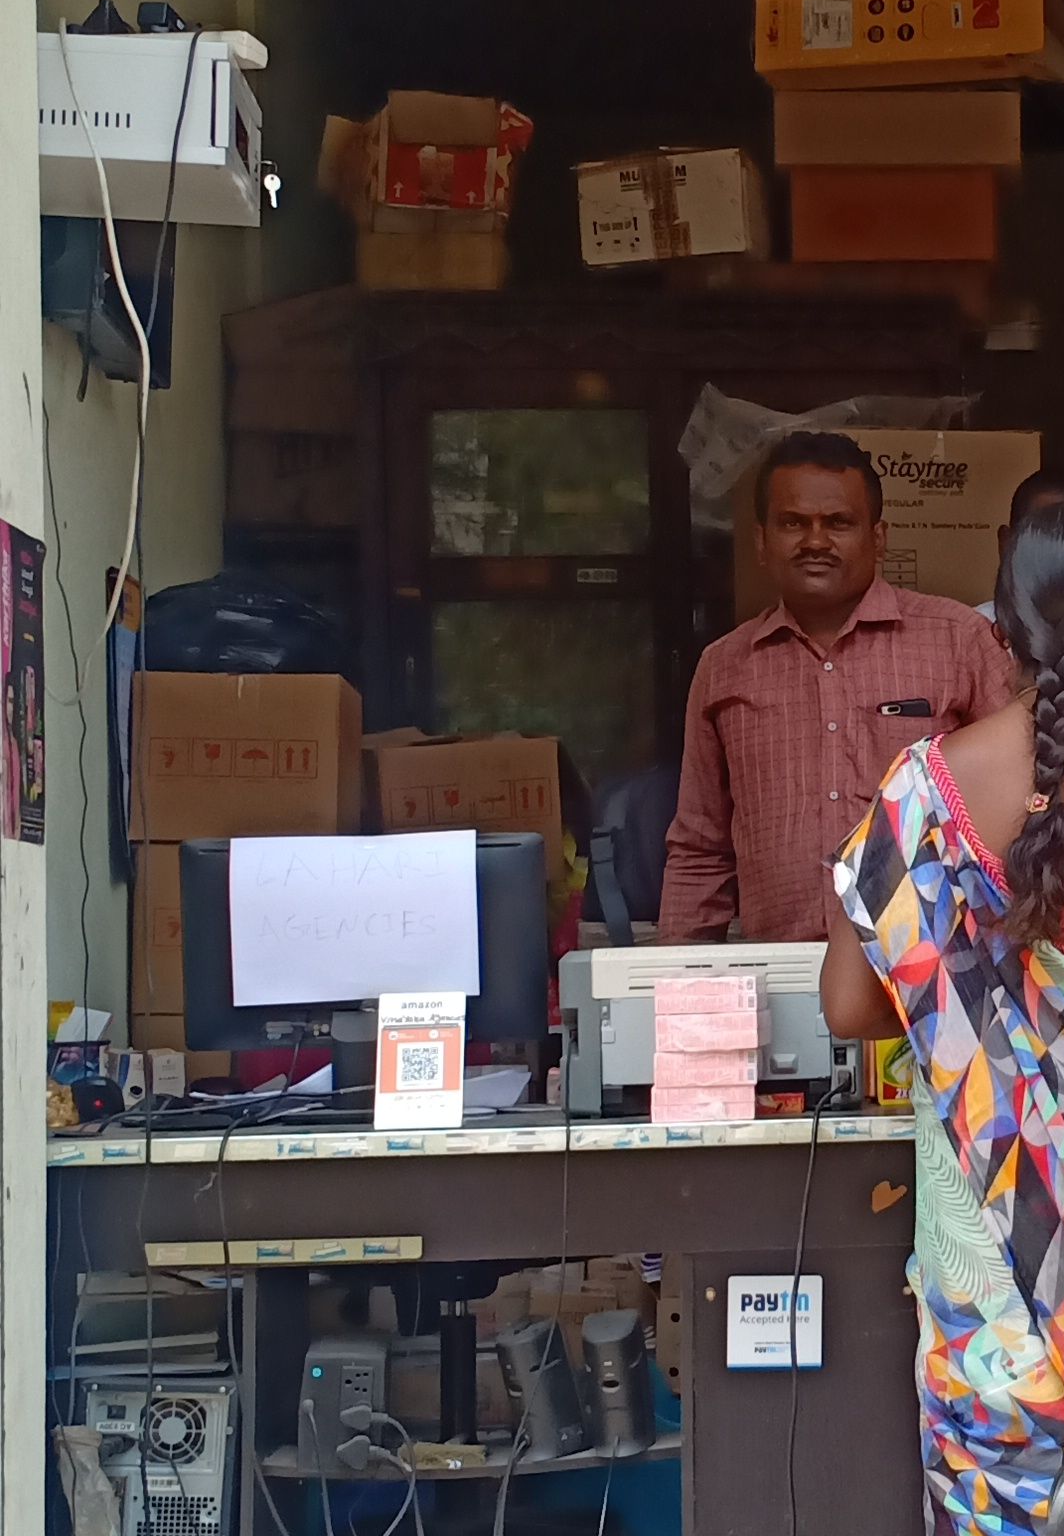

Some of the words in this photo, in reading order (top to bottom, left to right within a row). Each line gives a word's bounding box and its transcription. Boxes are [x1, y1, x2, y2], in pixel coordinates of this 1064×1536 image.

[877, 453, 968, 483] Stayfree
[401, 1000, 443, 1010] amazon
[740, 1315, 784, 1325] Accepted
